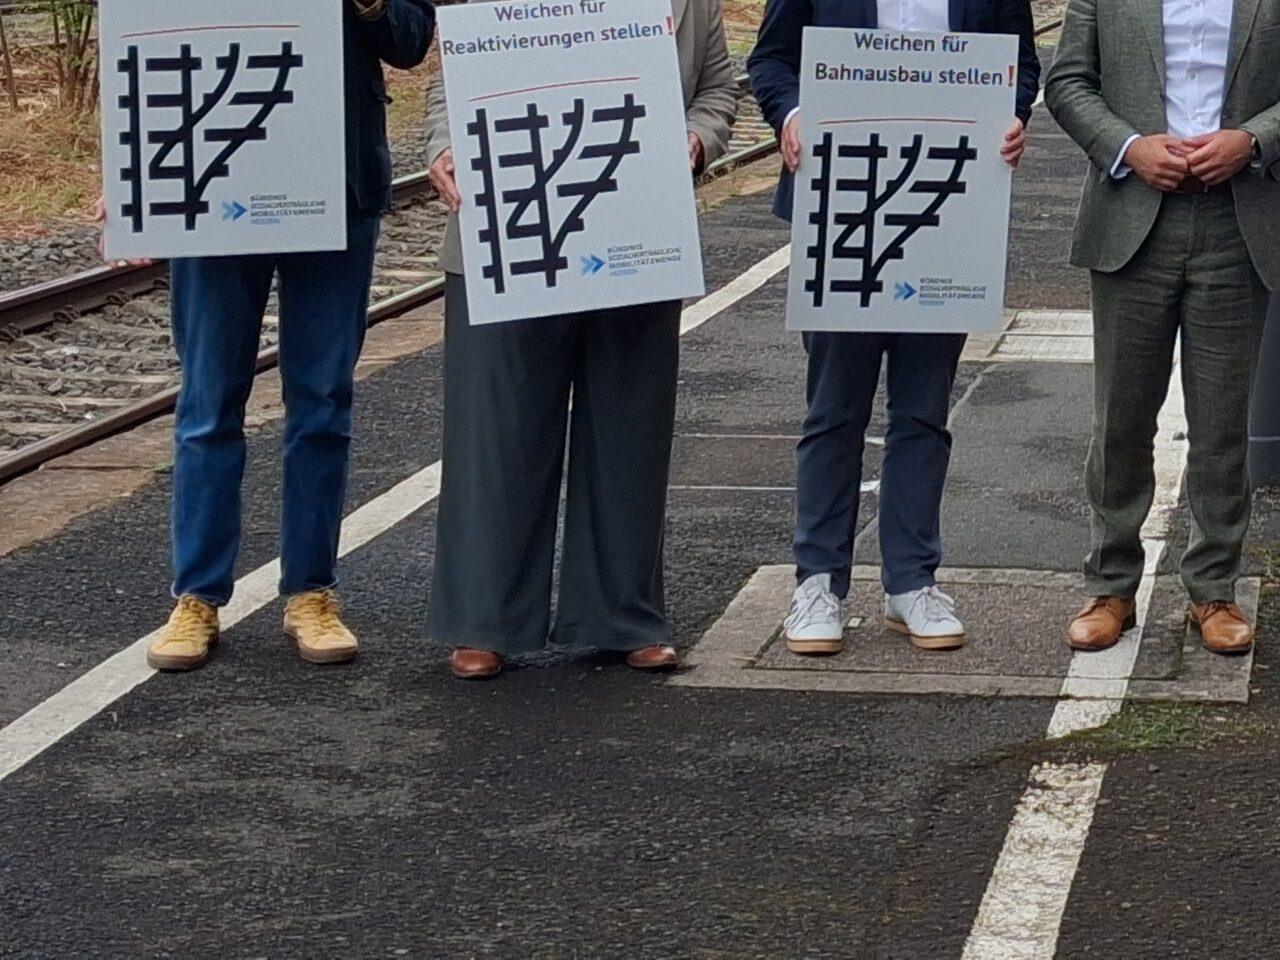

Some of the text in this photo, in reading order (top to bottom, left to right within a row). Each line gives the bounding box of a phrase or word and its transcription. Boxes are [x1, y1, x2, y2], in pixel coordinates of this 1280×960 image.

[494, 0, 575, 22] Weichen
[442, 30, 597, 56] Reaktivierungen
[854, 32, 969, 53] Weichen für
[815, 63, 932, 83] Bahnausbau
